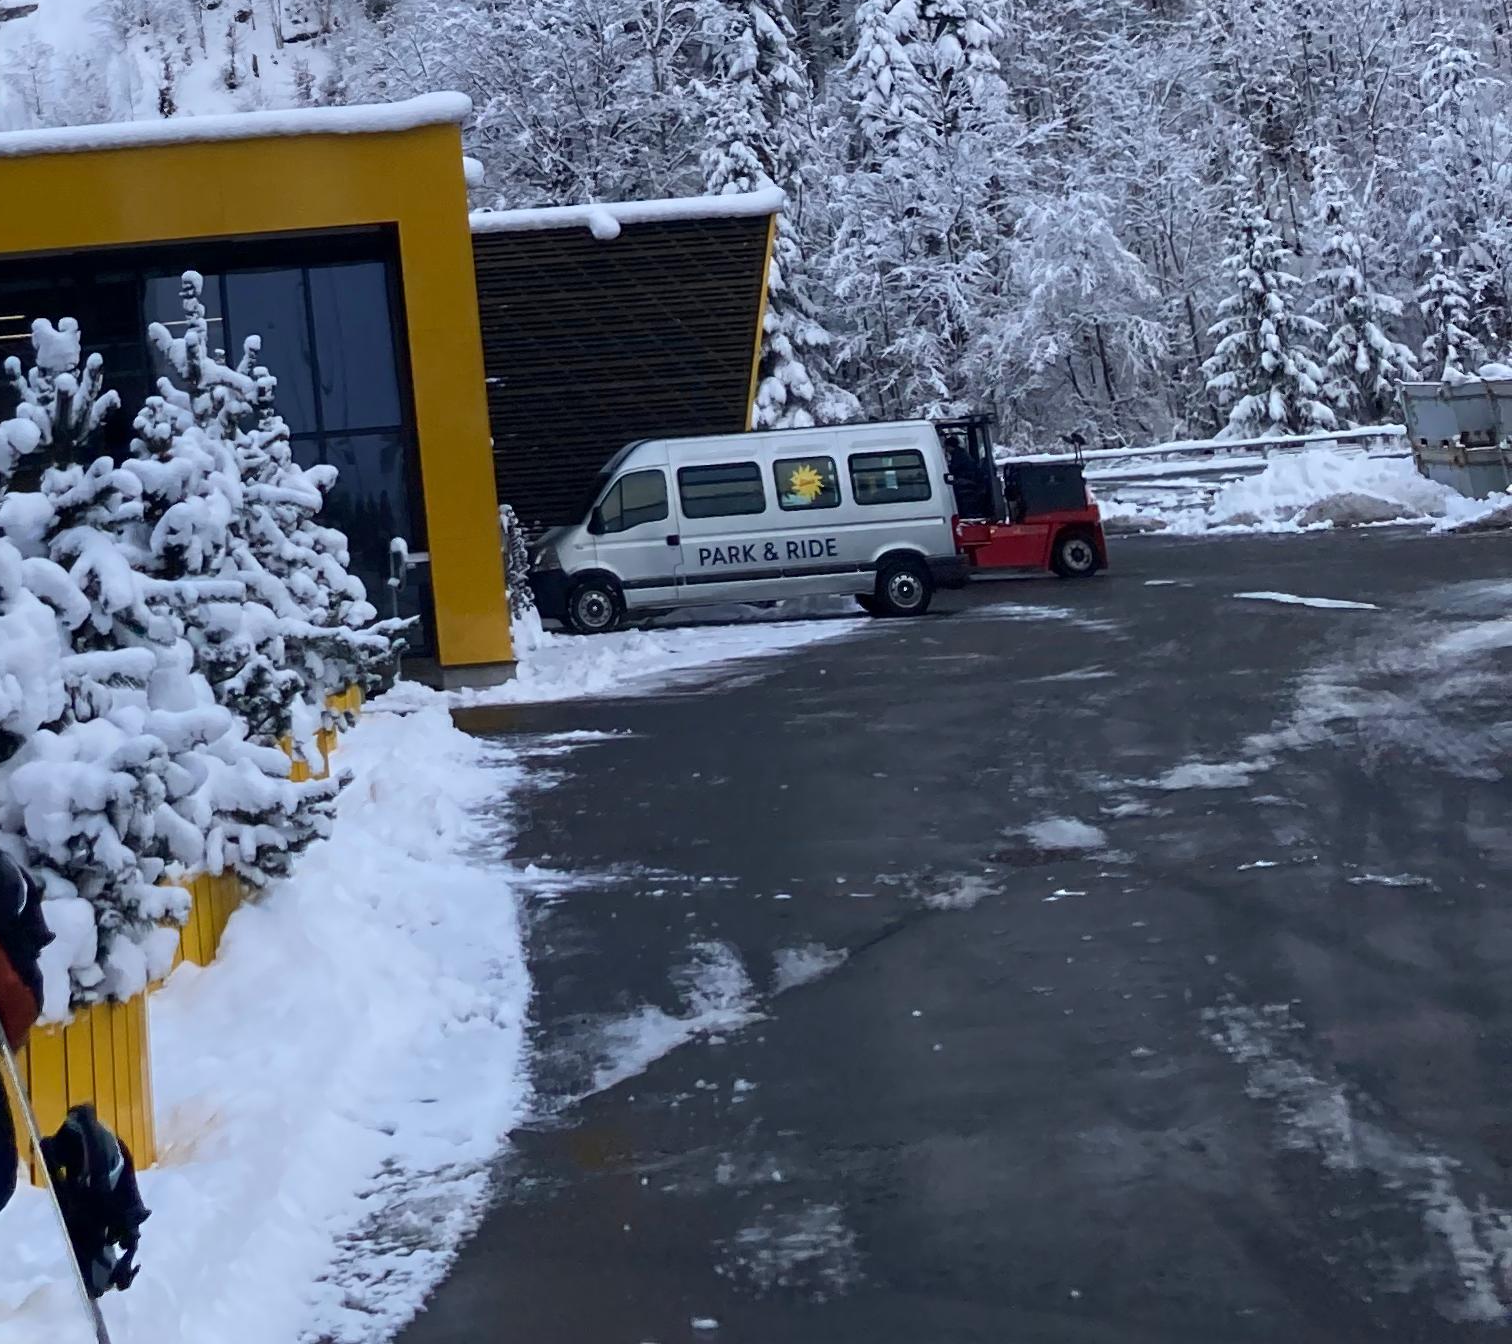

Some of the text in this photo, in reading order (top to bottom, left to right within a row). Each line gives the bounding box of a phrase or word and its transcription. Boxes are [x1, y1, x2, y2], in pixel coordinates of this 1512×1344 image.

[699, 538, 838, 567] PARK & RIDE
